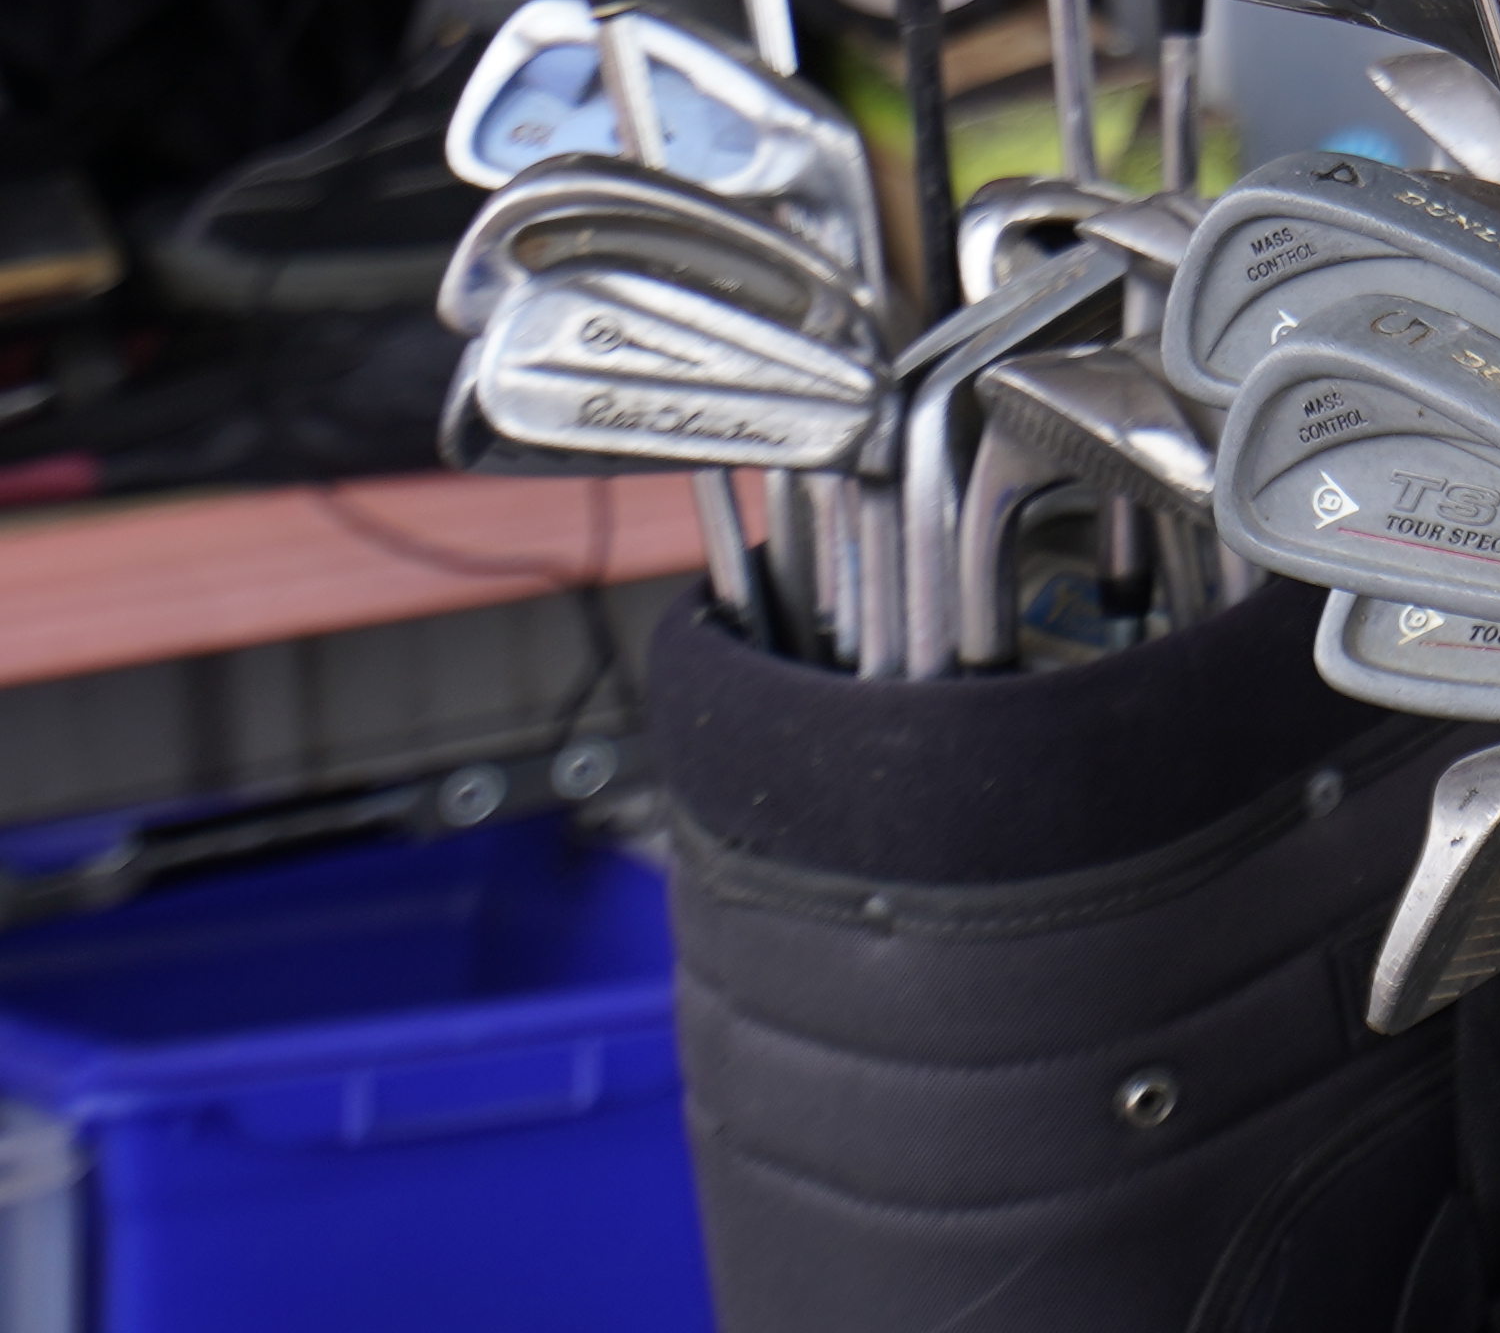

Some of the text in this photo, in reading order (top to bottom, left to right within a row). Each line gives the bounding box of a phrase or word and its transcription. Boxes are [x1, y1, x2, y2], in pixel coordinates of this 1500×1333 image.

[1250, 227, 1295, 258] MASS
[1246, 243, 1319, 283] CONTROL
[1303, 391, 1345, 420] MASS
[1298, 409, 1369, 445] CONTROL
[1385, 514, 1445, 542] TOUR
